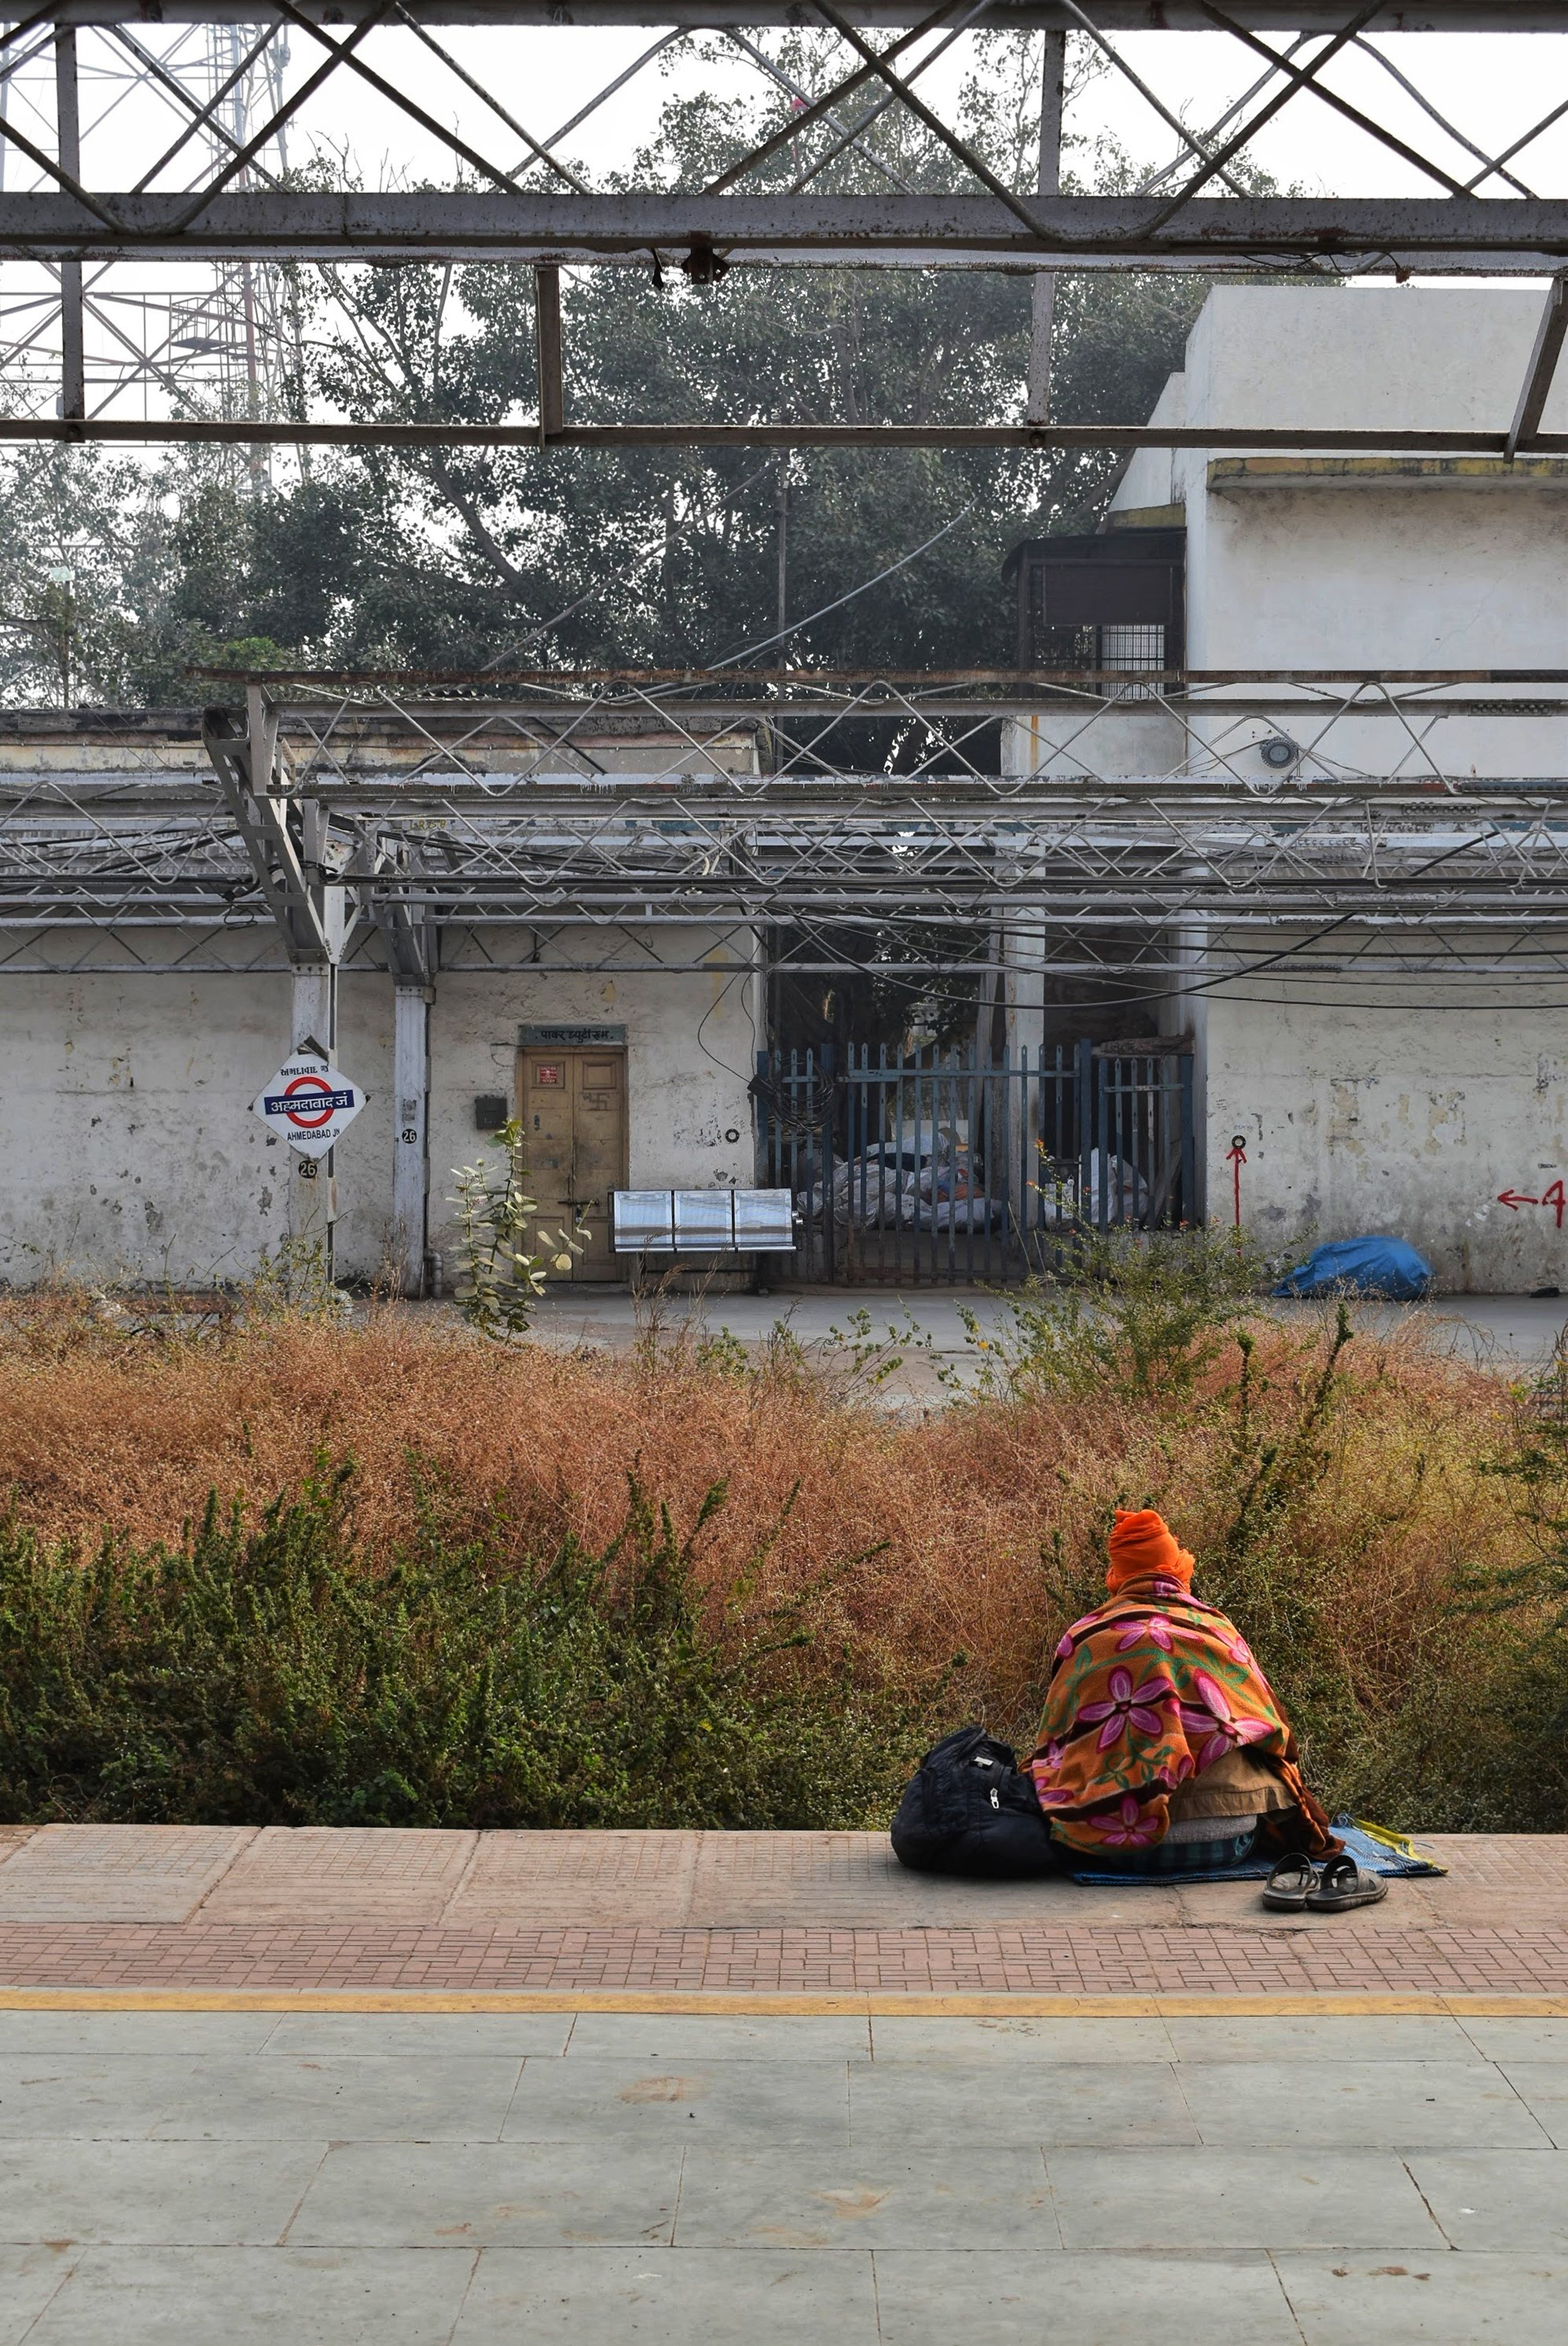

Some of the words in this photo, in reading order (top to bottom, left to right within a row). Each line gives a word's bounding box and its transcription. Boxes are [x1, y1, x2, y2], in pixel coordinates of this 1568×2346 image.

[541, 1030, 565, 1041] पावर
[592, 1030, 610, 1041] रूम
[280, 1066, 318, 1076] અમદાવાદ
[270, 1097, 334, 1112] अहमदाबाद
[335, 1091, 348, 1106] जं
[287, 1129, 332, 1141] AHMEDABAD
[332, 1128, 341, 1137] JN
[403, 1131, 416, 1142] 26
[301, 1162, 316, 1176] 26
